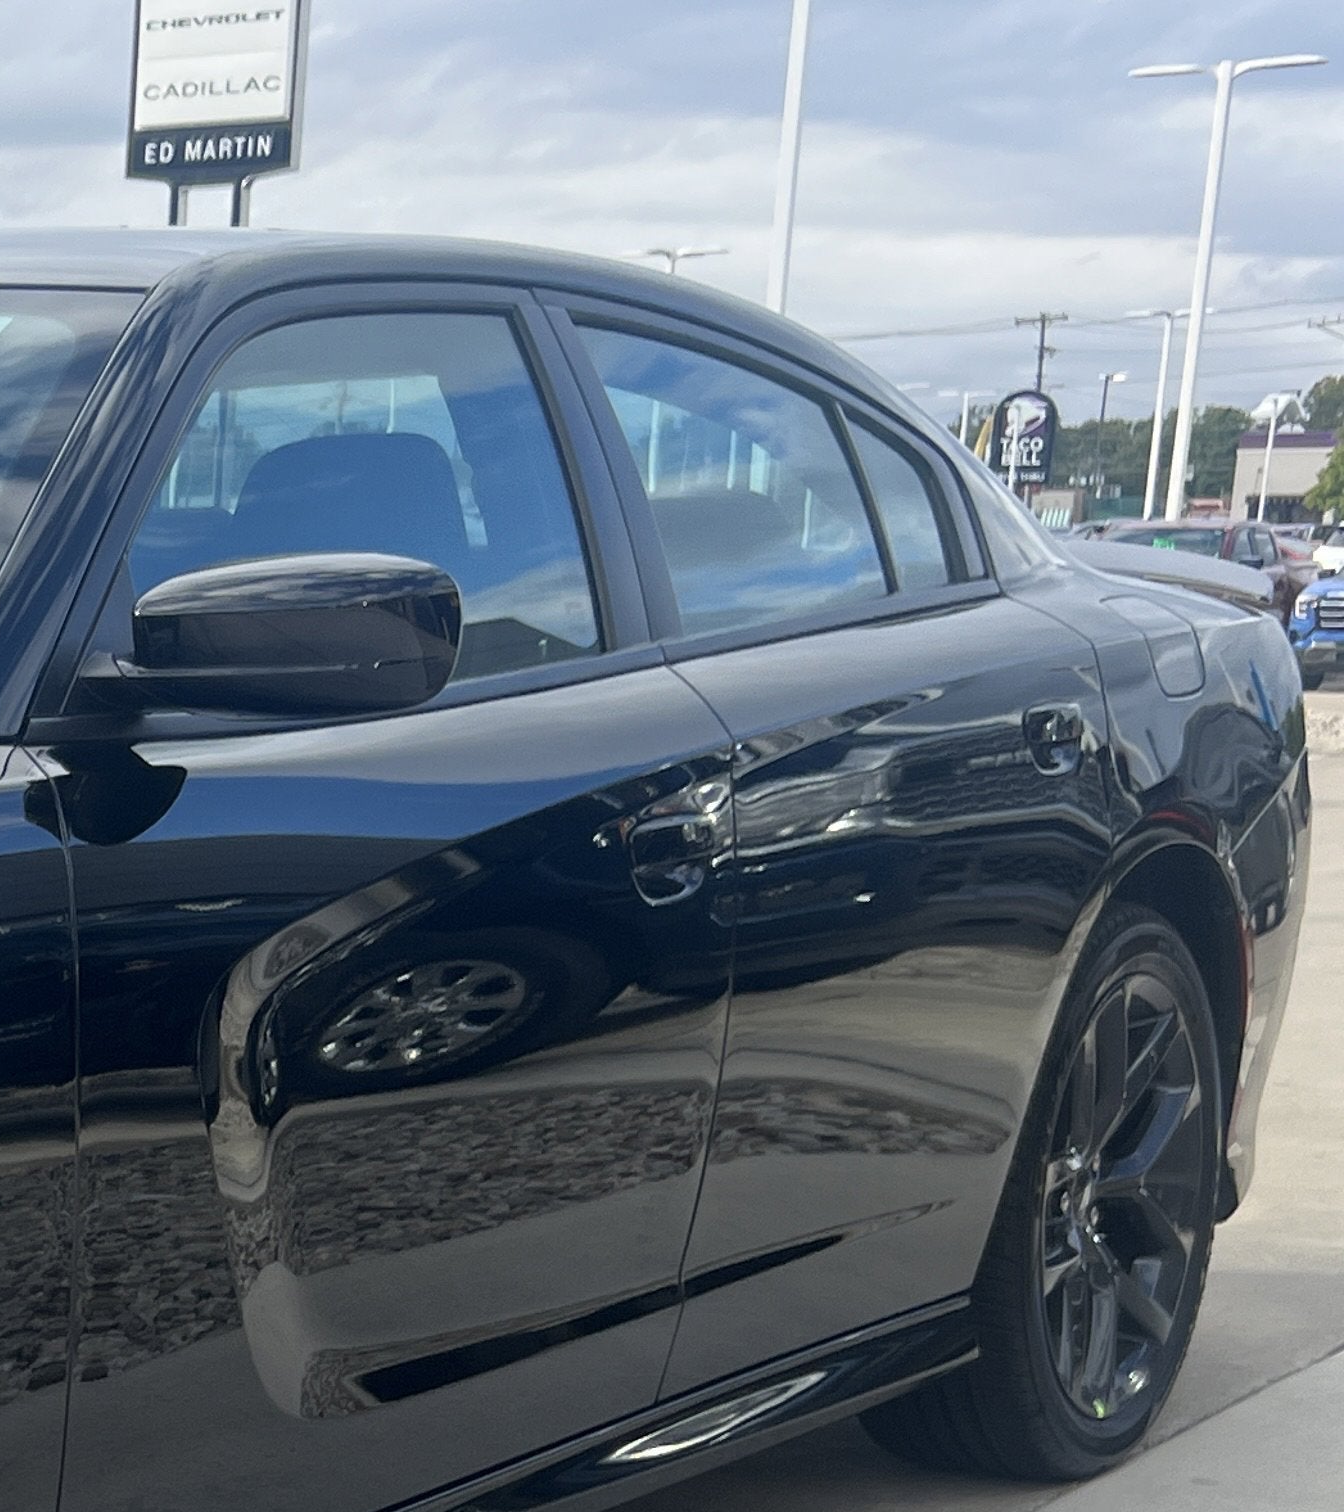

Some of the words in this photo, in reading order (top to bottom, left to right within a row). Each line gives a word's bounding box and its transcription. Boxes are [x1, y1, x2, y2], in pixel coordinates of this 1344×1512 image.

[145, 9, 286, 31] CHEVROLET
[142, 75, 282, 101] CADILLAC
[143, 142, 175, 165] ED
[184, 135, 273, 163] MARTIN
